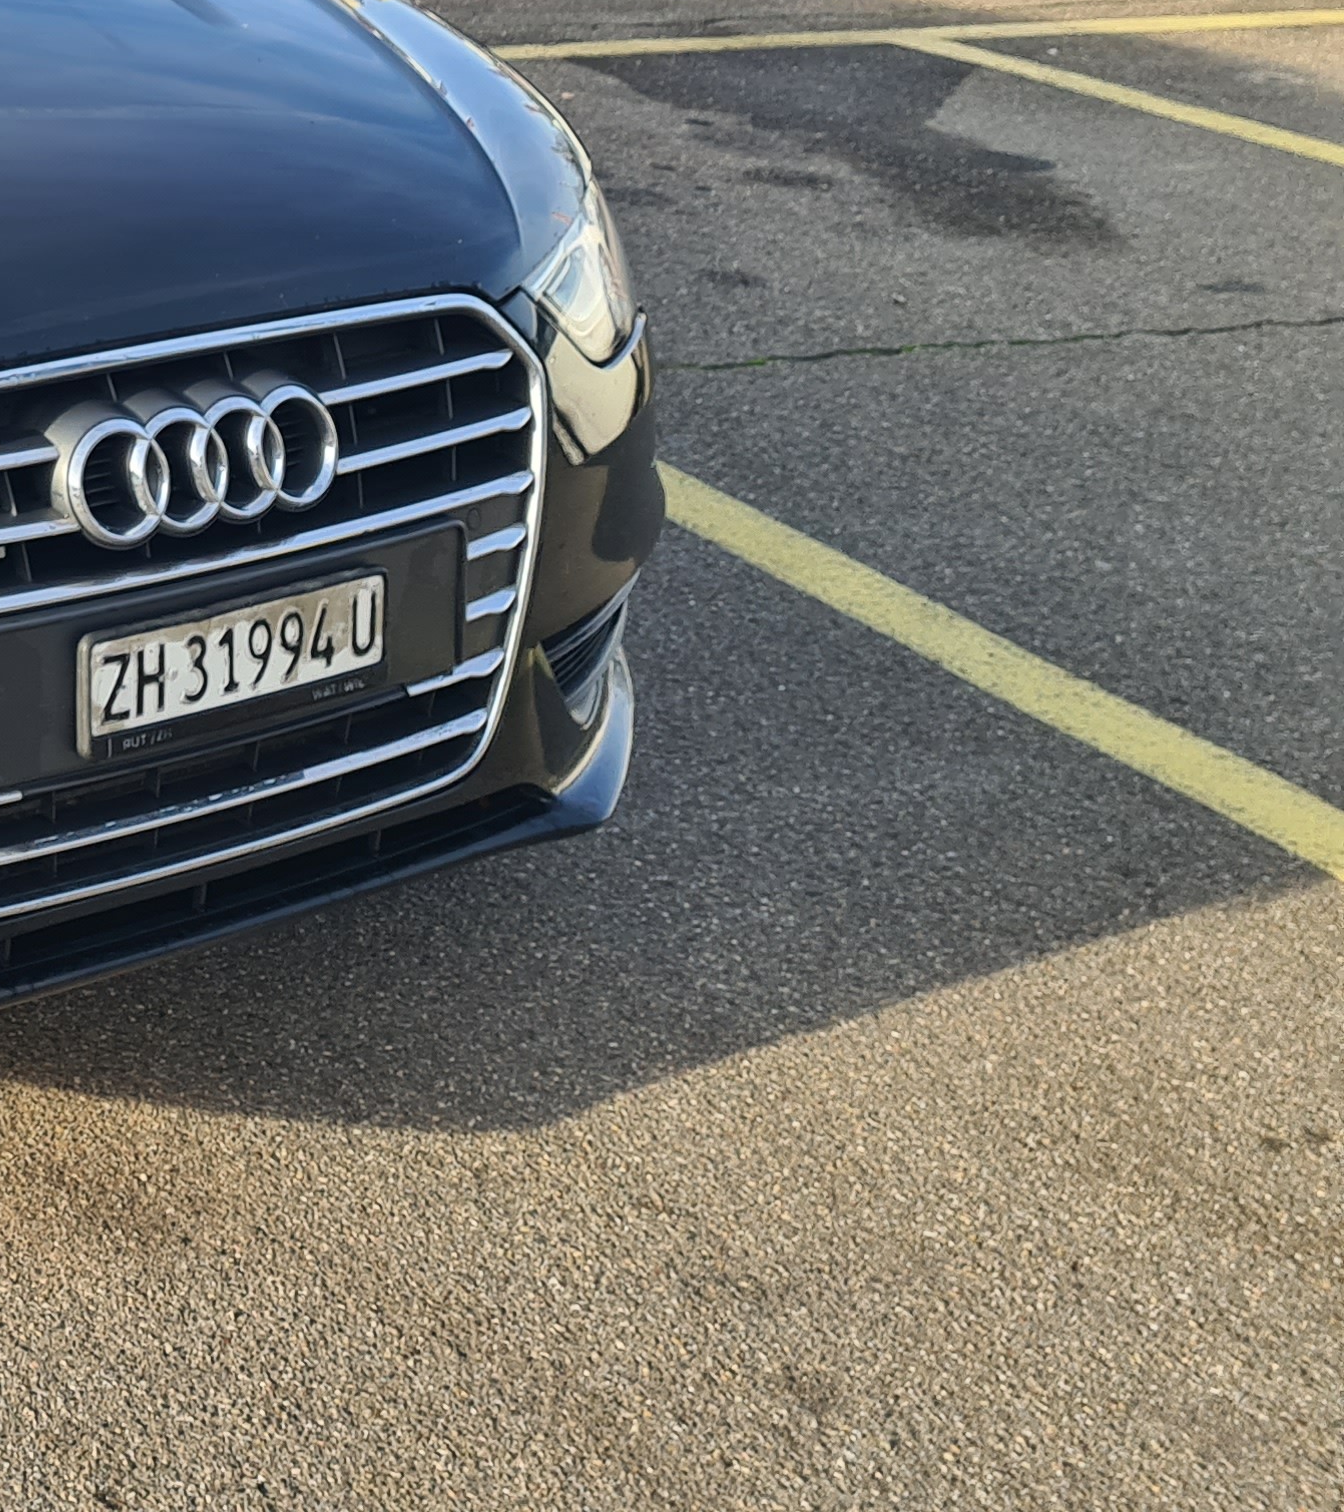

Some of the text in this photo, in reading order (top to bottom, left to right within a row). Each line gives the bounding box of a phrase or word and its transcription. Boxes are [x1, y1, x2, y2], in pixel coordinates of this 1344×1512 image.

[100, 590, 377, 726] ZH 31994 U
